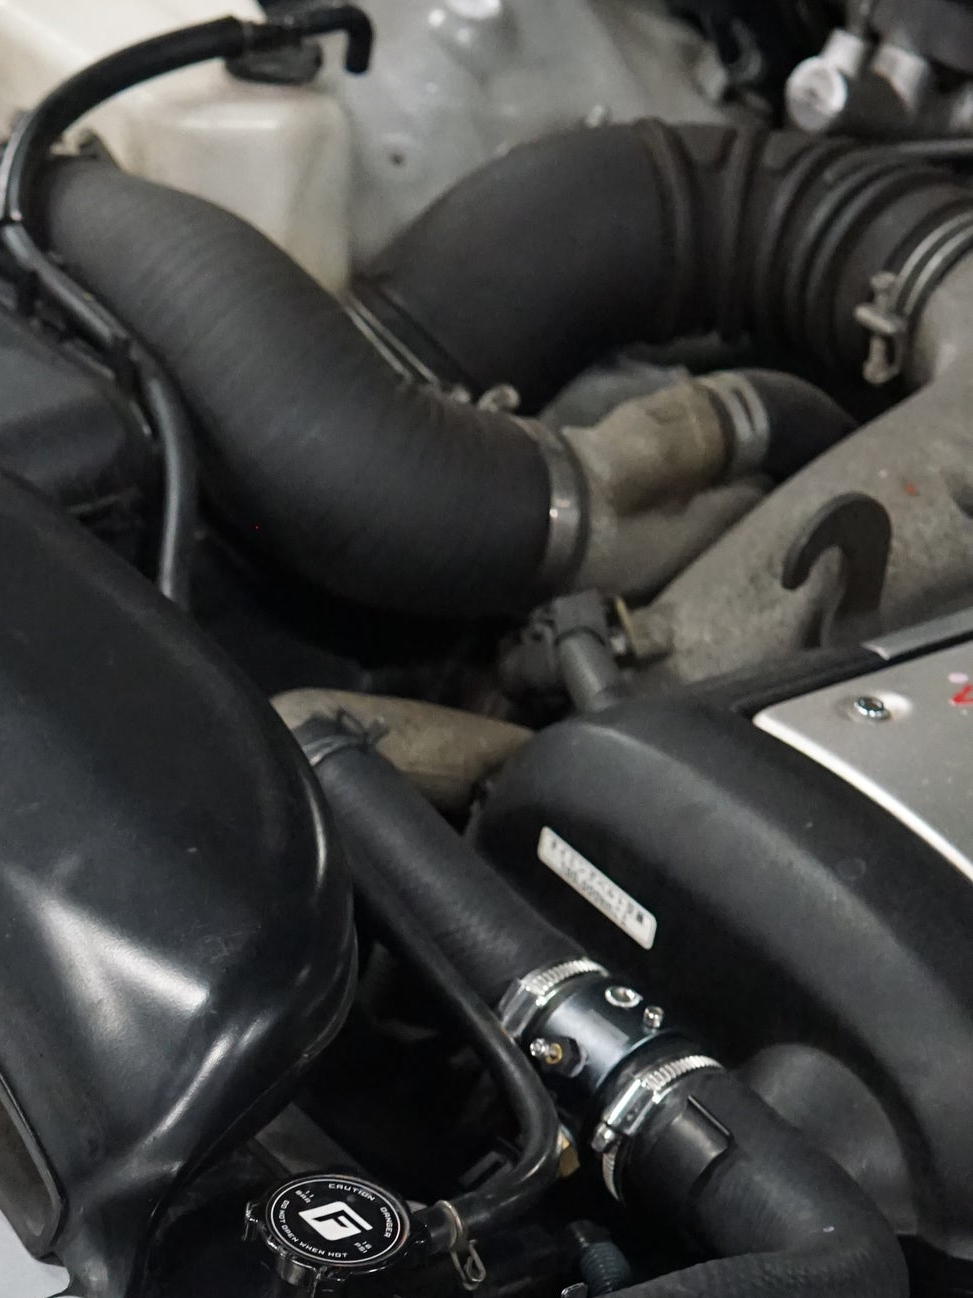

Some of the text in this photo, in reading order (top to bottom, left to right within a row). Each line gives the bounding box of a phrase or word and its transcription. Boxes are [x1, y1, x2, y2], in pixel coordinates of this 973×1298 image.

[295, 1190, 311, 1203] BAR
[328, 1183, 375, 1201] CAUTION
[280, 1200, 290, 1209] DO
[380, 1206, 393, 1238] DANGER
[281, 1225, 299, 1243] OPEN
[299, 1241, 325, 1255] WHEN
[354, 1242, 367, 1253] PSI
